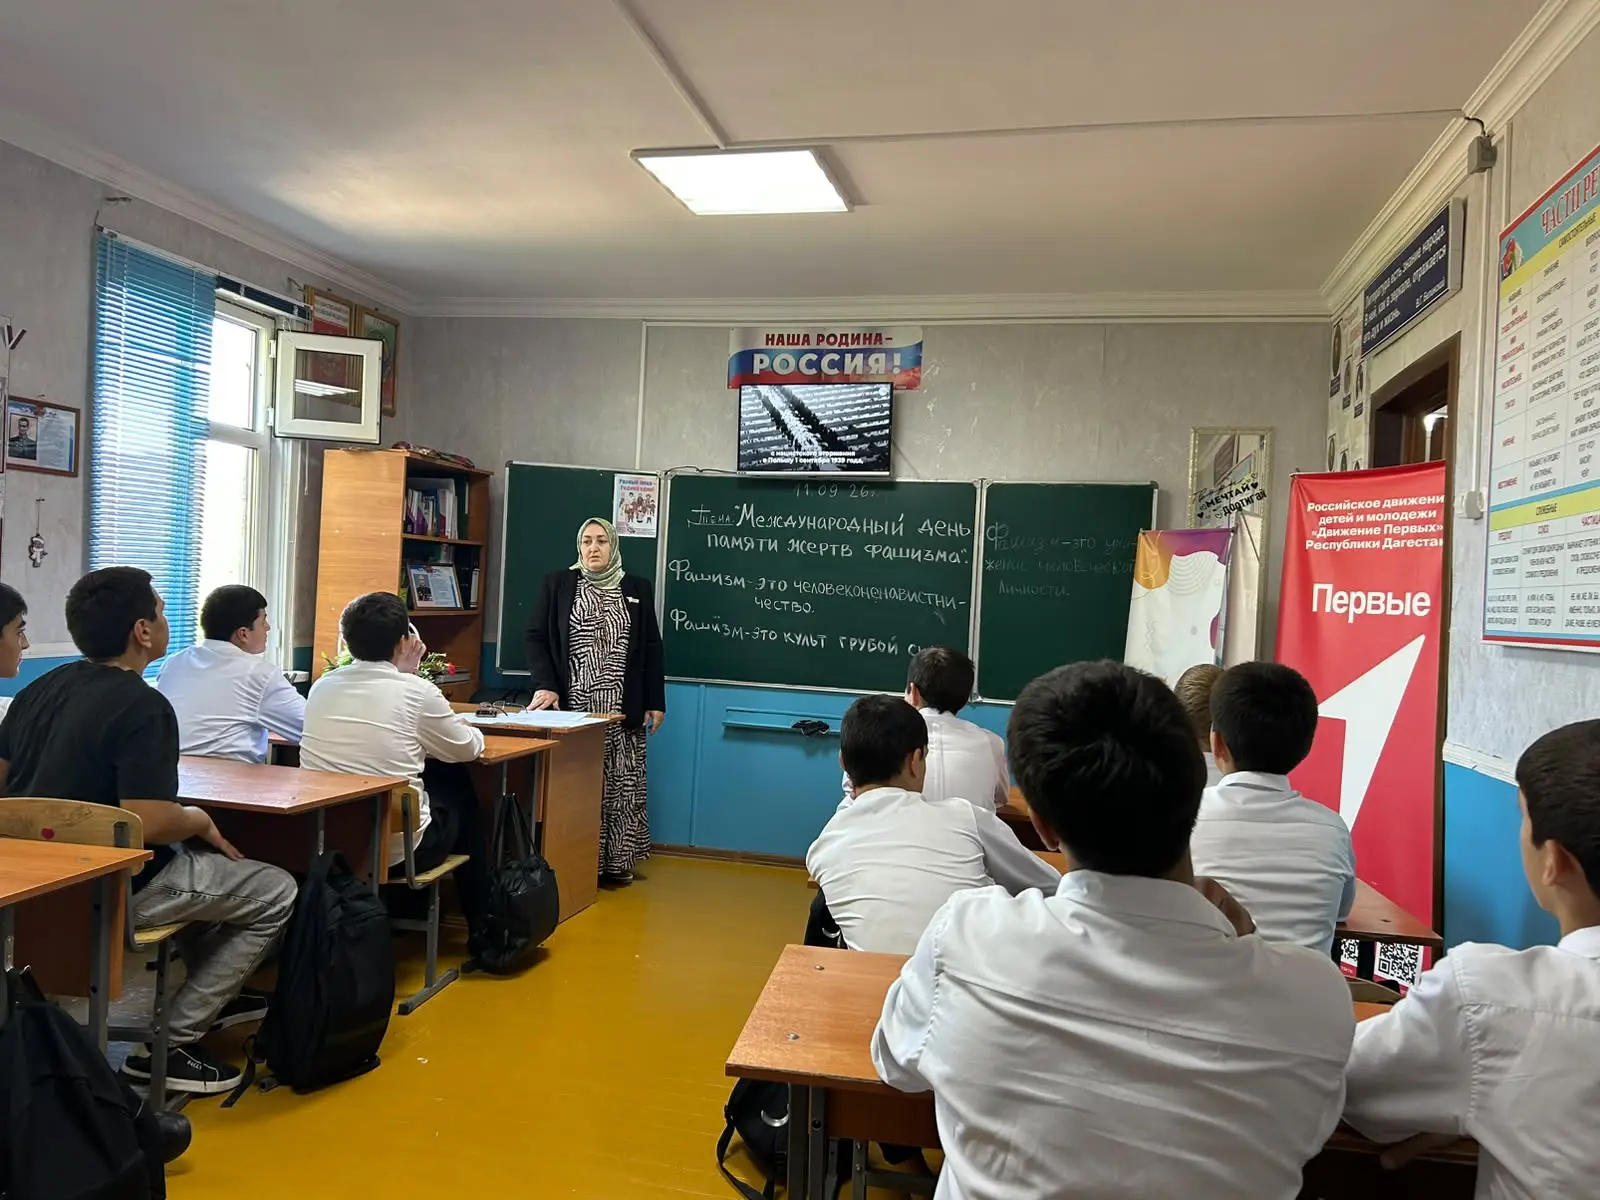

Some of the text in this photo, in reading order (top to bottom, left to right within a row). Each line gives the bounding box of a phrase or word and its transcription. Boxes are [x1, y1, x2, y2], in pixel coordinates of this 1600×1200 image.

[1583, 163, 1600, 204] РЕ
[765, 333, 811, 346] НАША
[753, 353, 901, 375] РОССИЯ!
[1205, 483, 1251, 509] МЕЧТАЙ
[1307, 500, 1381, 513] Российское
[1318, 510, 1437, 525] детей и молодежи
[707, 533, 778, 552] памяти
[787, 538, 853, 557] жертв
[1305, 538, 1381, 551] Республики
[754, 596, 815, 613] чество.
[1311, 583, 1431, 624] Первые
[783, 631, 827, 648] культ
[838, 635, 898, 656] грубой
